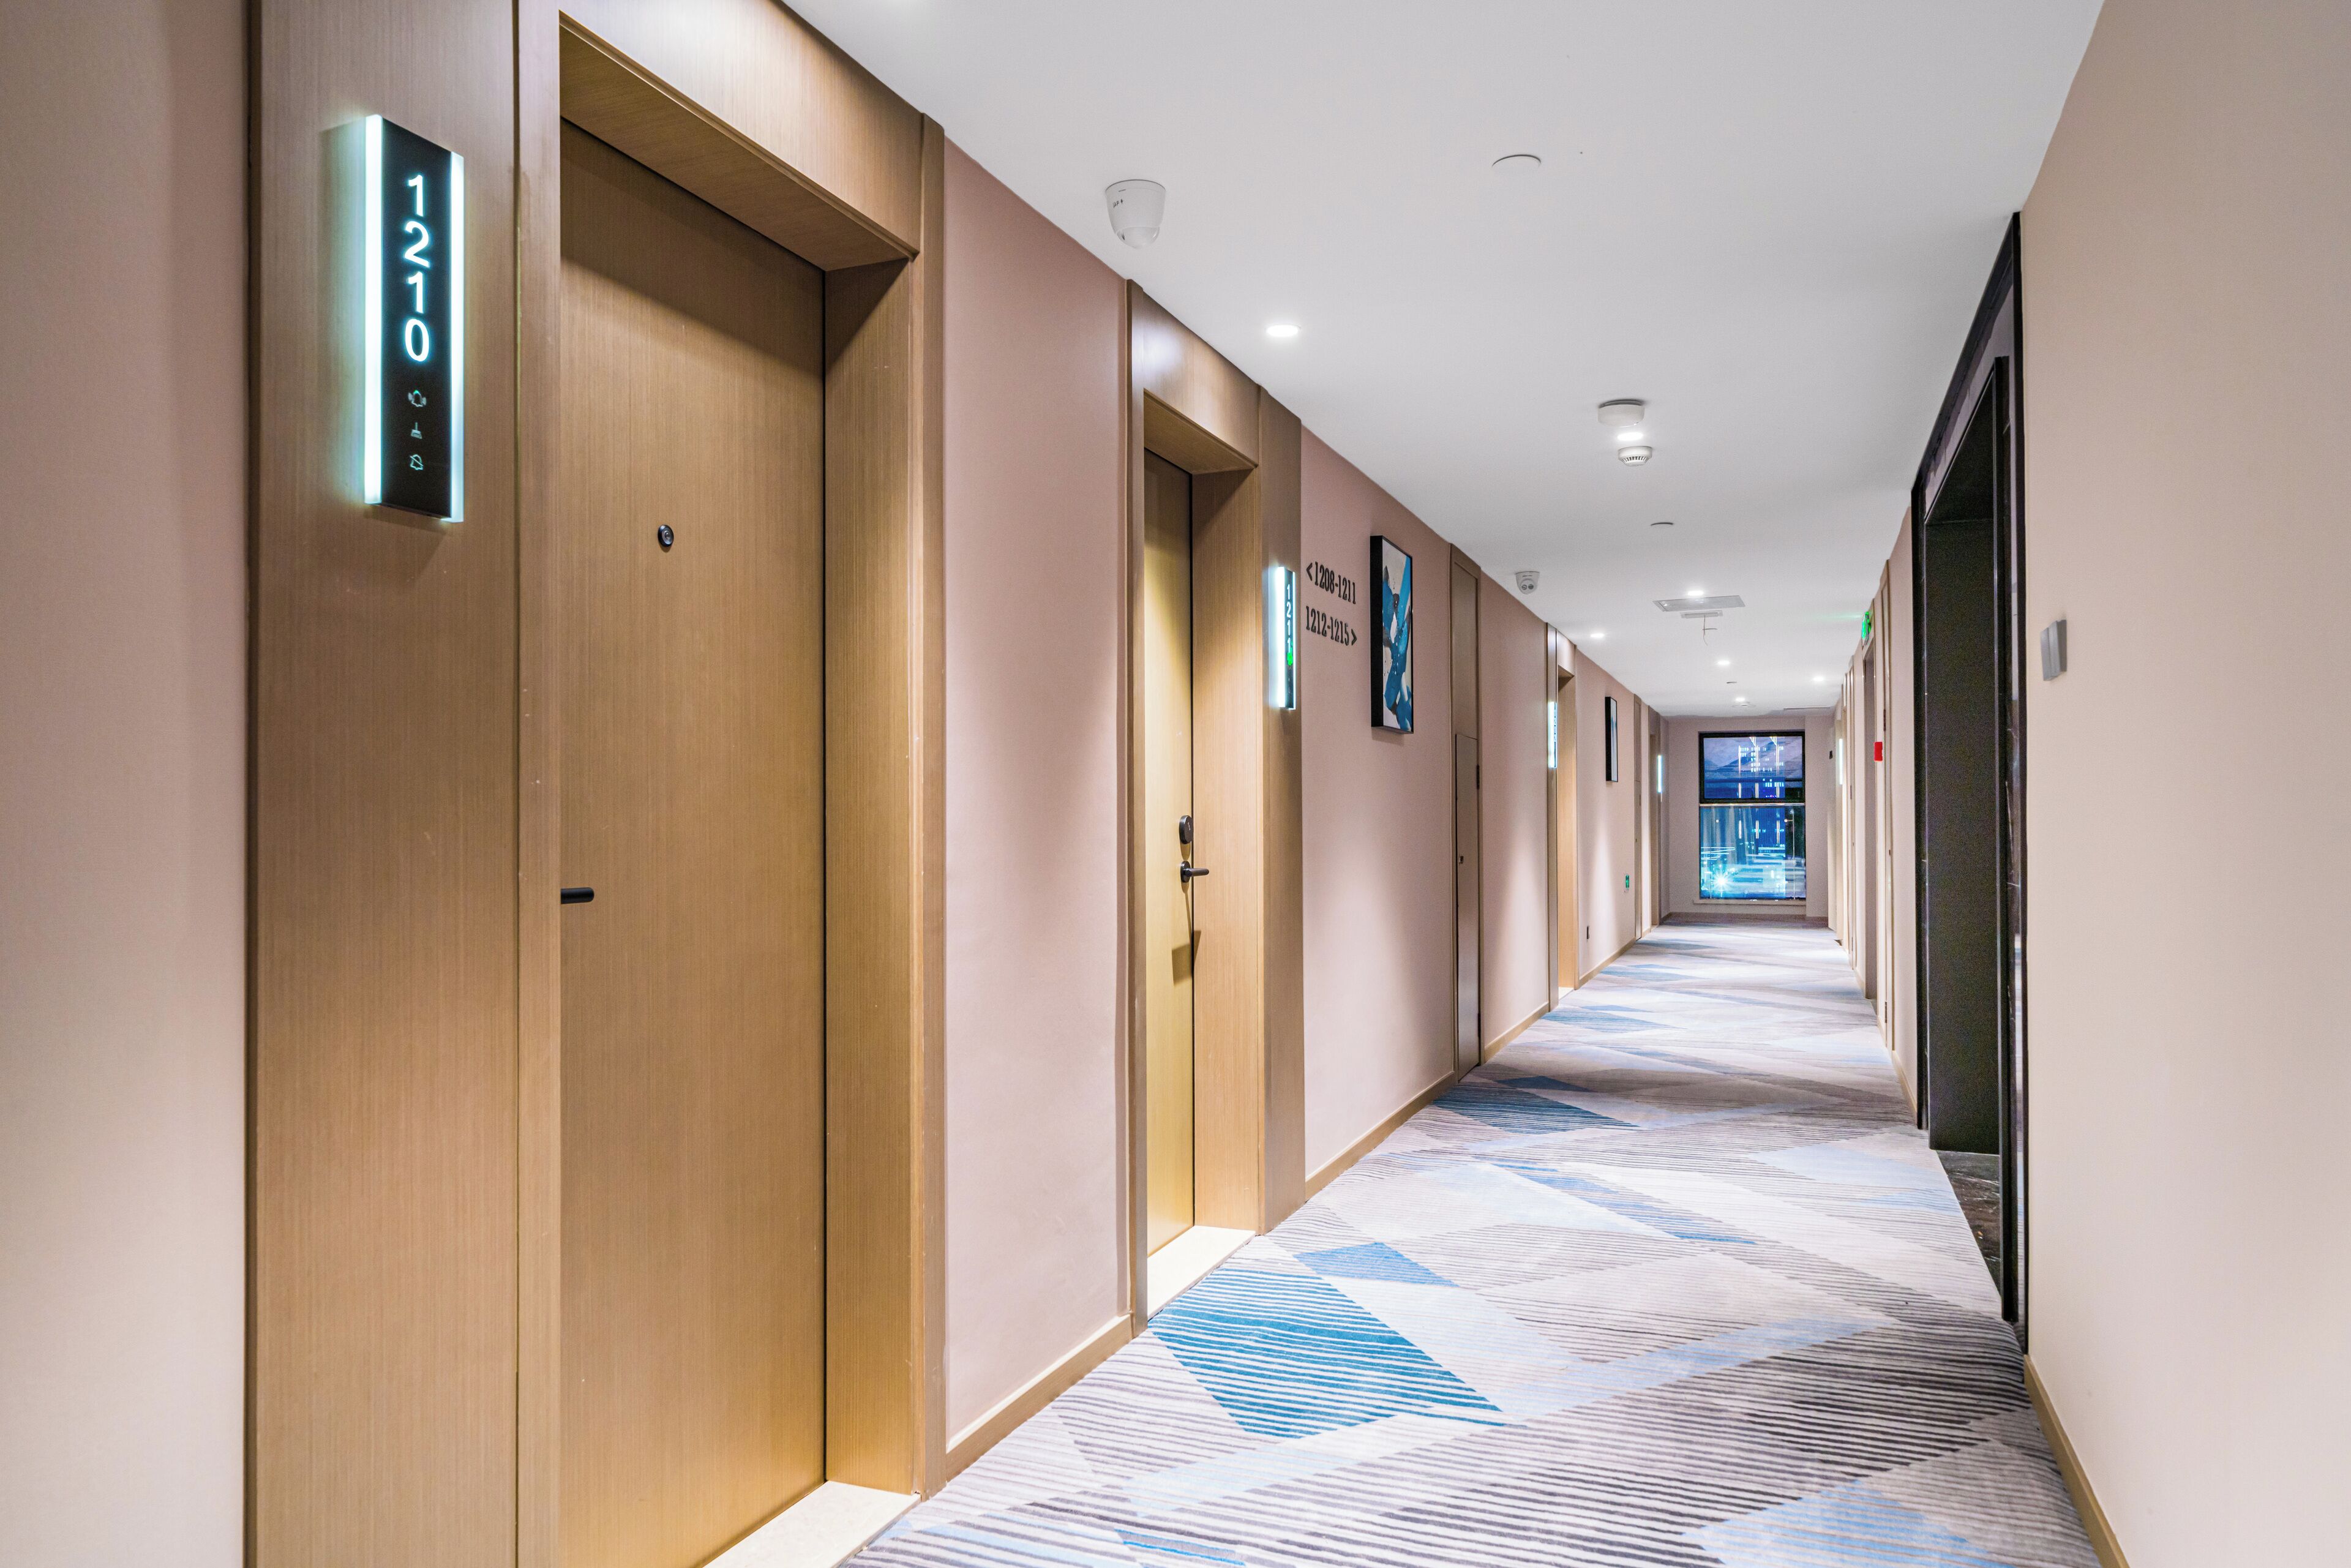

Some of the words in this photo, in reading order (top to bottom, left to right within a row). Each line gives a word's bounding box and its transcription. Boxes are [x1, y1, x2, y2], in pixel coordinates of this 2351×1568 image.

[404, 174, 430, 362] 1210
[1314, 561, 1356, 604] 1208-1211
[1306, 606, 1349, 646] 1212-1215
